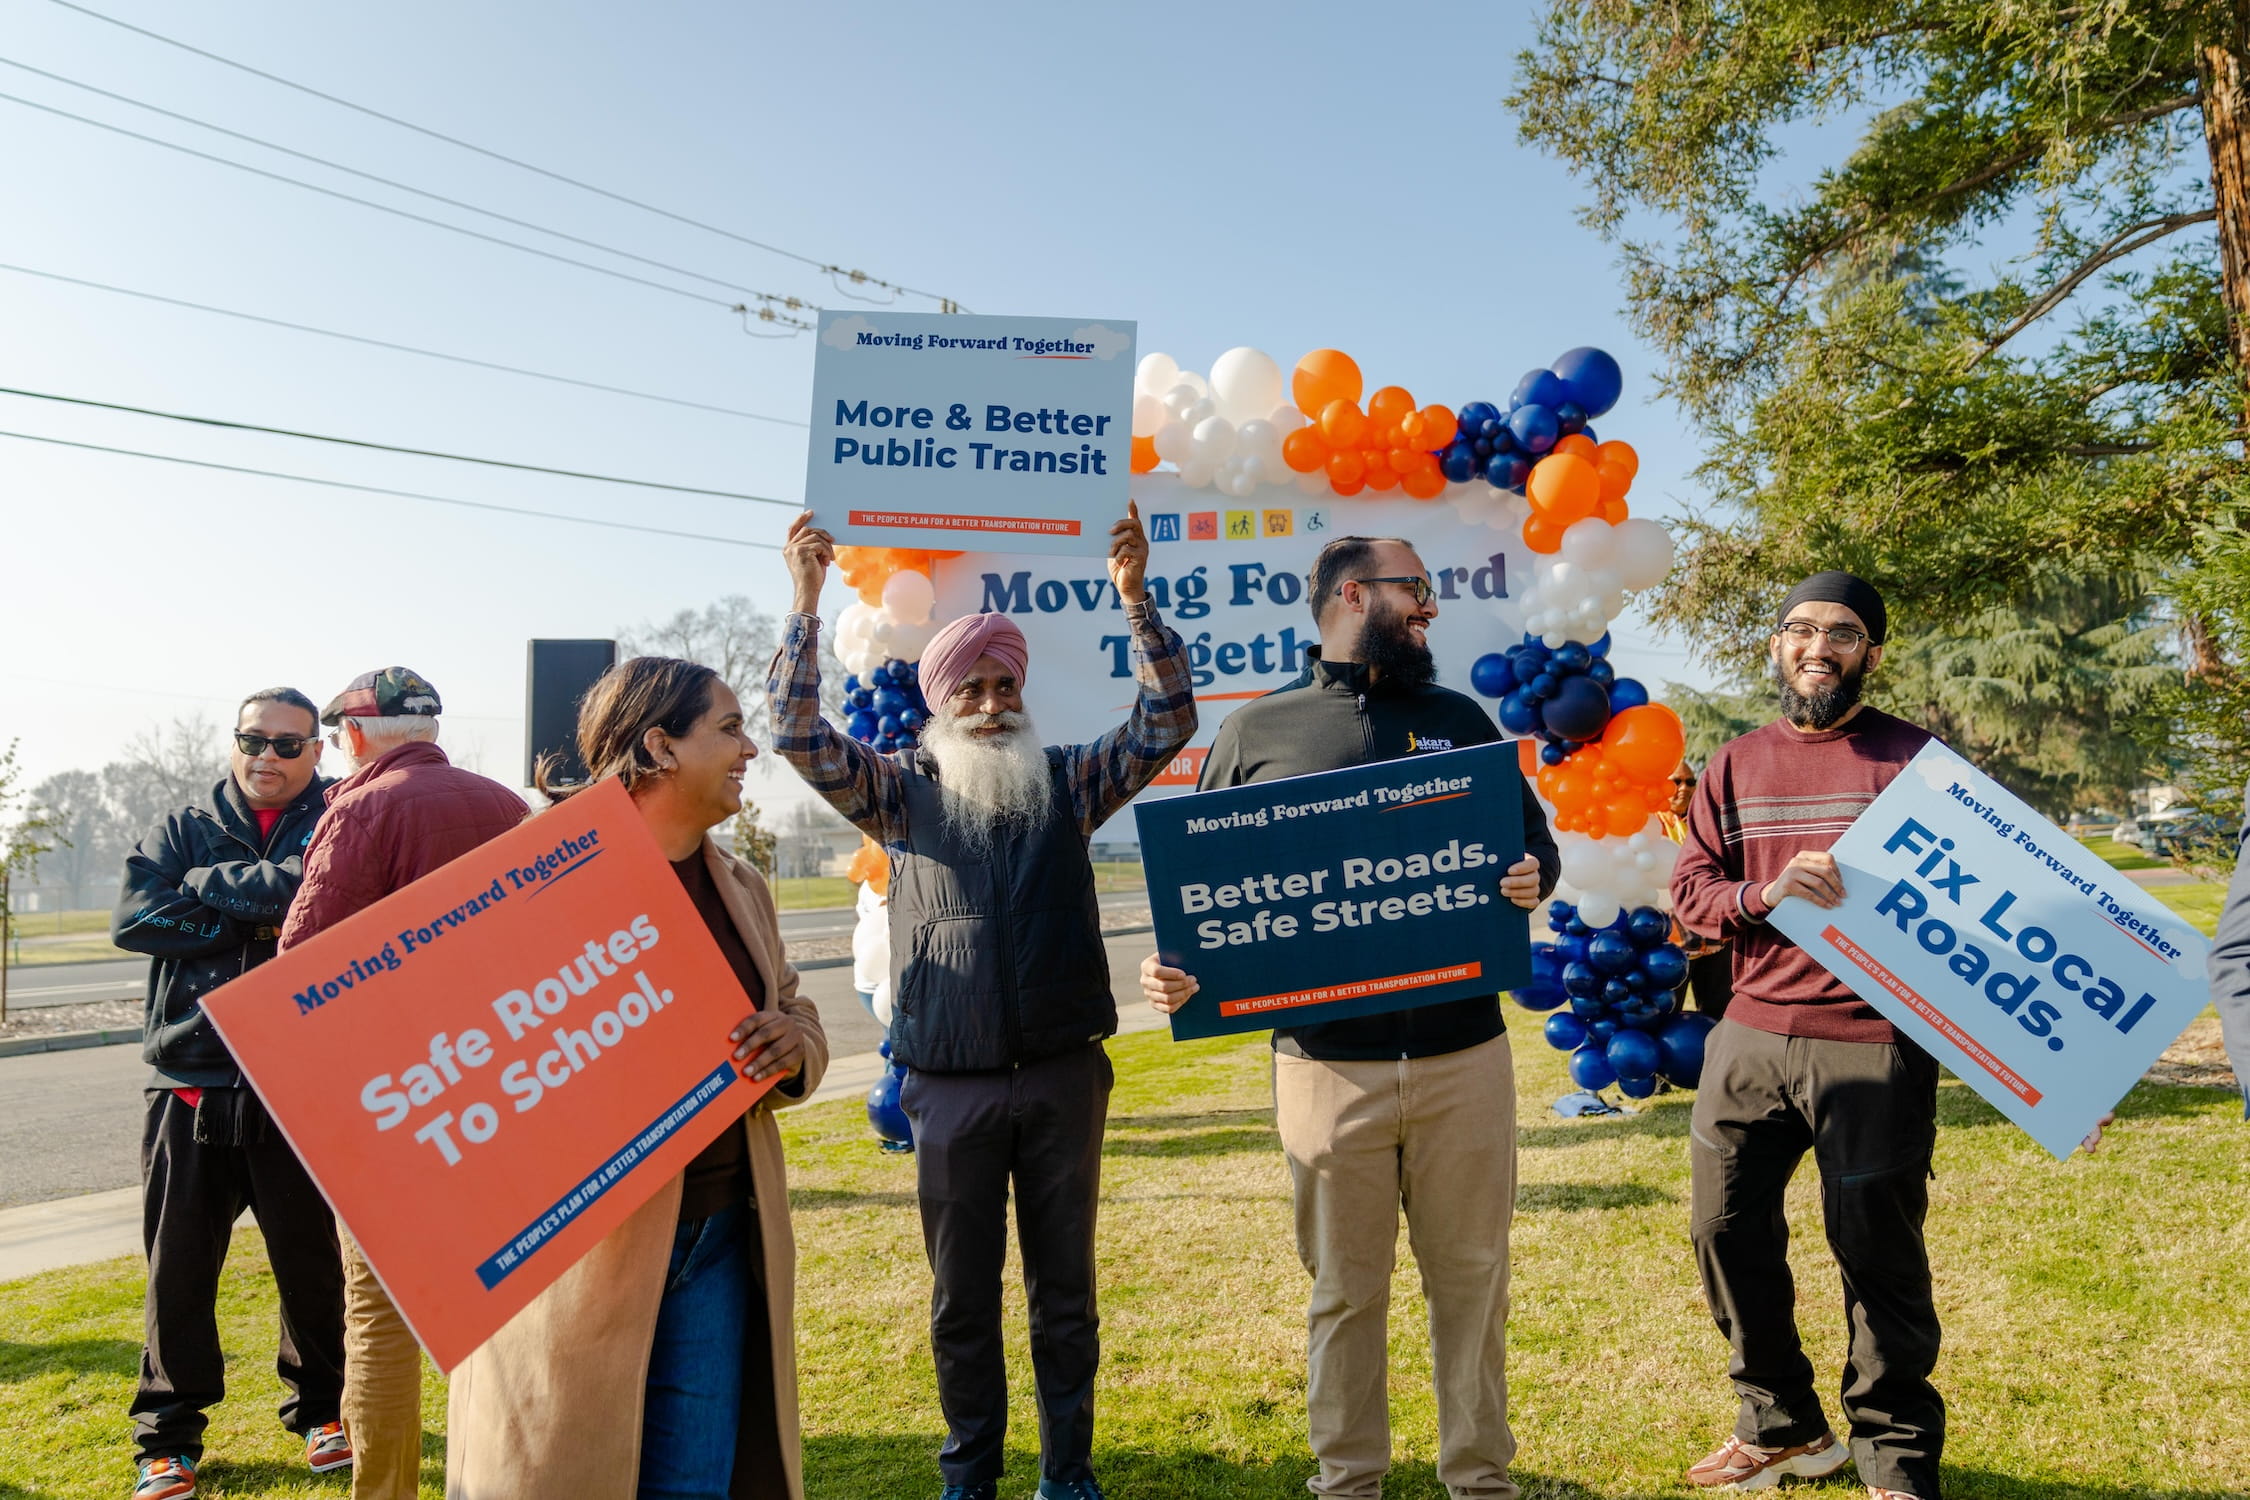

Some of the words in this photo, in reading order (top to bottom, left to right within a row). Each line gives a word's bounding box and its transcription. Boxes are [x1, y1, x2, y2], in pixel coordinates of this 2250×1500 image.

[857, 332, 923, 350] Moving
[928, 334, 1007, 350] Forward
[1013, 337, 1095, 354] Together
[835, 400, 934, 430] More
[945, 403, 972, 431] &
[986, 404, 1111, 436] Better
[834, 437, 958, 470] Public
[969, 442, 1107, 475] Transit
[862, 514, 876, 523] THE
[877, 515, 909, 524] PEOPLE'S
[910, 516, 928, 525] PLAN
[930, 517, 944, 526] FOR
[945, 518, 950, 526] A
[952, 518, 978, 527] BETTER
[981, 520, 1040, 530] TRANSPORTATION
[1042, 522, 1069, 532] FUTURE
[1229, 552, 1508, 606] Ford
[1099, 627, 1315, 688] Tgeth
[1160, 757, 1192, 776] OR
[1186, 808, 1269, 834] Moving
[1272, 790, 1369, 822] Forward
[1374, 776, 1472, 804] Together
[1180, 867, 1329, 915] Better
[1342, 840, 1498, 889] Roads.
[1946, 782, 2016, 838] Moving
[2013, 830, 2098, 896] Forward
[2097, 891, 2182, 960] Together
[292, 942, 402, 1016] Moving
[398, 880, 508, 954] Forward
[504, 829, 600, 890] Together
[1198, 910, 1299, 950] Safe
[1312, 881, 1490, 932] Streets.
[1883, 816, 1980, 906] Fix
[1979, 888, 2157, 1035] Local
[1235, 1002, 1250, 1012] THE
[1252, 996, 1288, 1009] PEOPLE'S
[1290, 994, 1311, 1004] PLAN
[1312, 990, 1328, 1000] FOR
[1337, 984, 1367, 996] BETTER
[1369, 973, 1436, 992] TRANSPORTATION
[1438, 968, 1468, 980] FUTURE
[1874, 878, 2064, 1052] Roads.
[360, 1032, 494, 1132] Safe
[491, 914, 660, 1042] Routes
[1834, 936, 1850, 950] THE
[1848, 946, 1880, 974] PEOPLE'S
[1878, 972, 1898, 988] PLAN
[1896, 986, 1912, 1000] FOR
[1909, 997, 1918, 1006] A
[1916, 1002, 1944, 1026] BETTER
[1942, 1023, 2002, 1073] TRANSPORTATION
[2000, 1070, 2029, 1096] FUTURE
[414, 1102, 500, 1168] To
[500, 970, 674, 1112] School.
[496, 1248, 518, 1270] THE
[516, 1213, 560, 1255] PEOPLE'S
[557, 1192, 584, 1220] PLAN
[580, 1179, 600, 1200] FOR
[598, 1173, 608, 1186] A
[605, 1147, 638, 1180] BETTER
[636, 1096, 699, 1152] TRANSPORTATION
[696, 1073, 725, 1102] FUTURE
